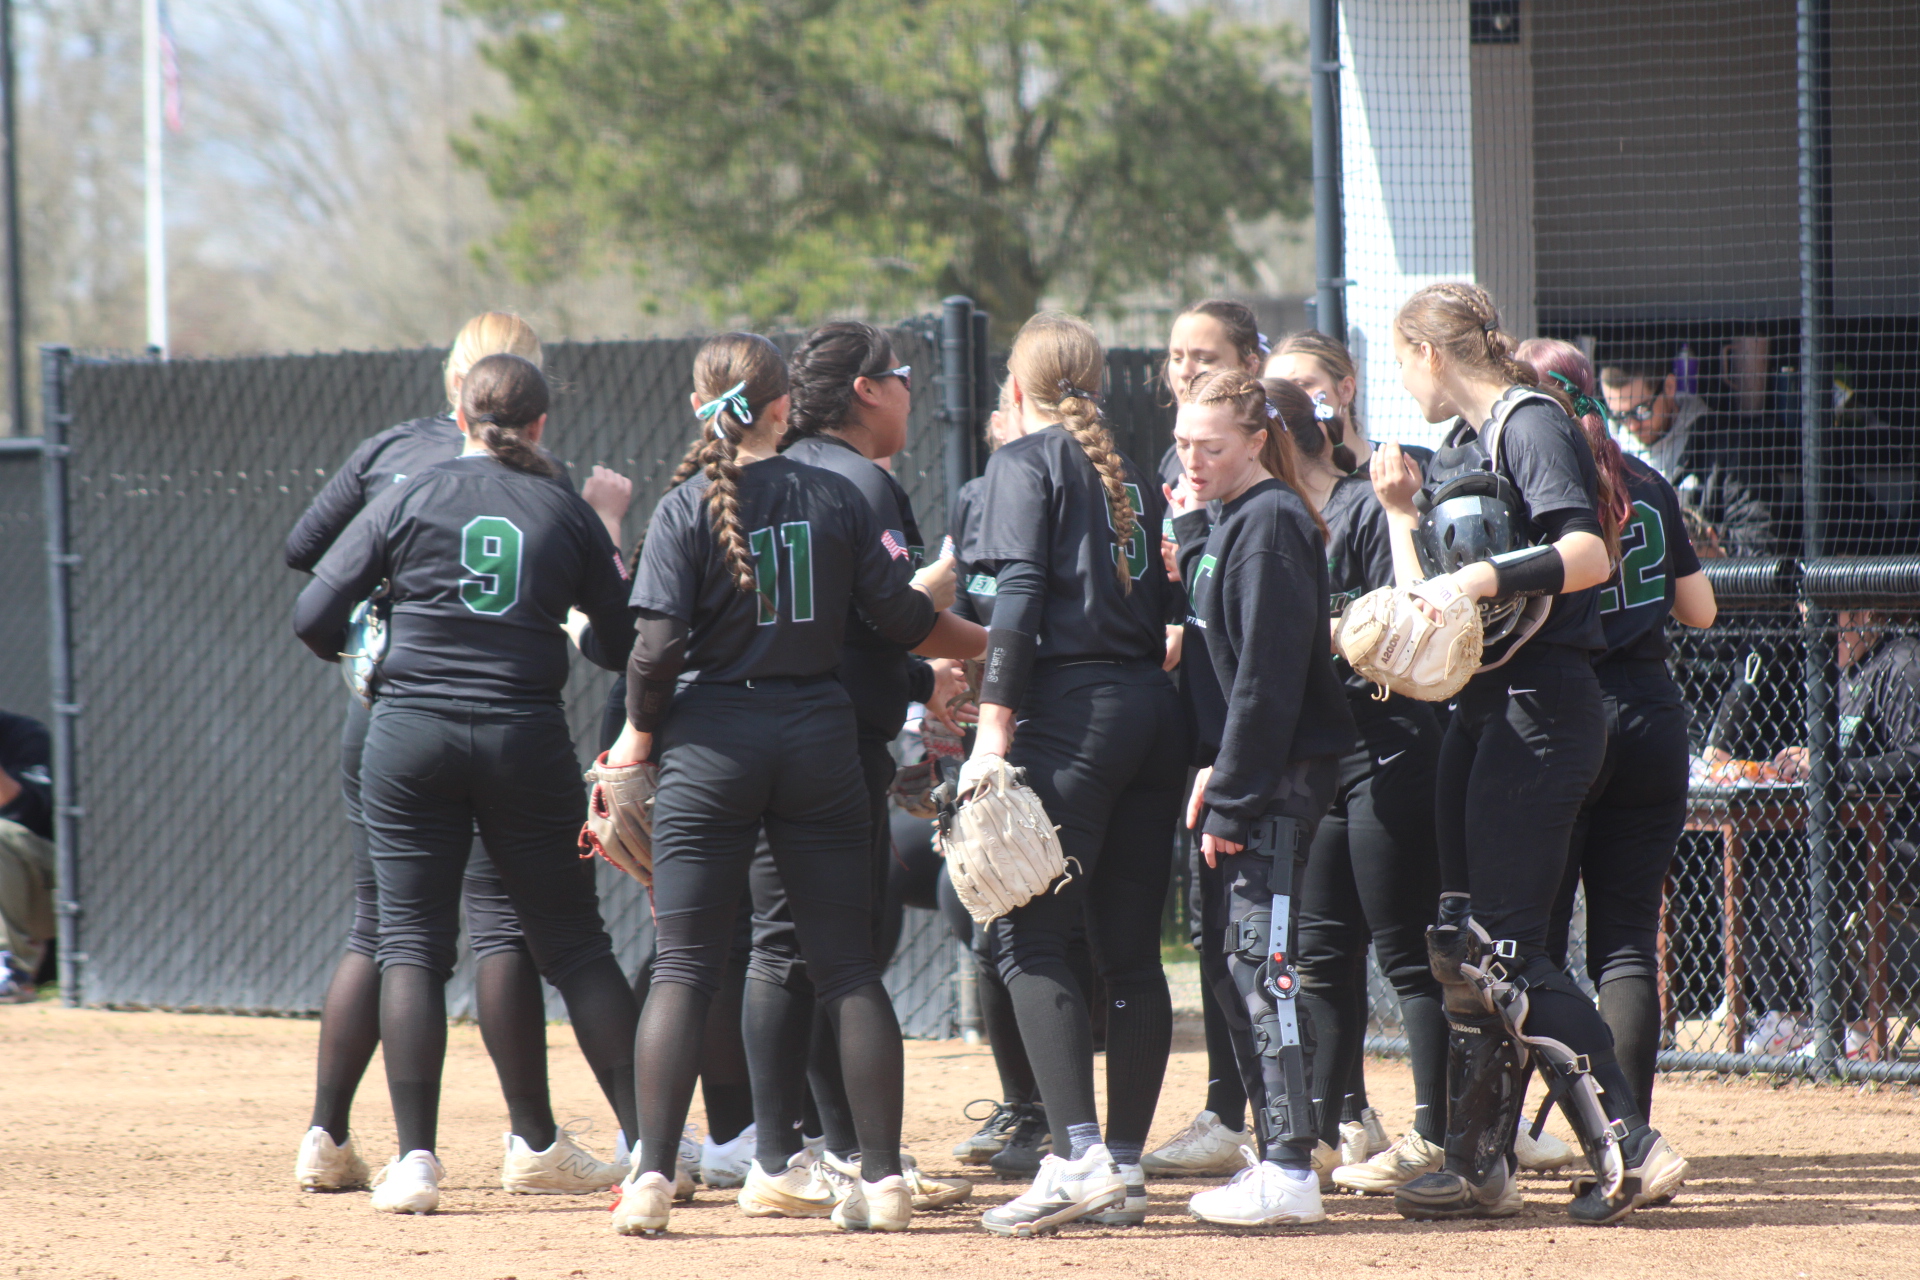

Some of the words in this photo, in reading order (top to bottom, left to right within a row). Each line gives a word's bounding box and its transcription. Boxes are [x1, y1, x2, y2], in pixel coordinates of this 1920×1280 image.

[459, 515, 523, 615] 9
[749, 521, 814, 625] 11
[1600, 500, 1666, 614] 2
[988, 646, 1004, 676] SPORTS
[1381, 633, 1401, 665] A2000
[1448, 1020, 1482, 1035] Wilson
